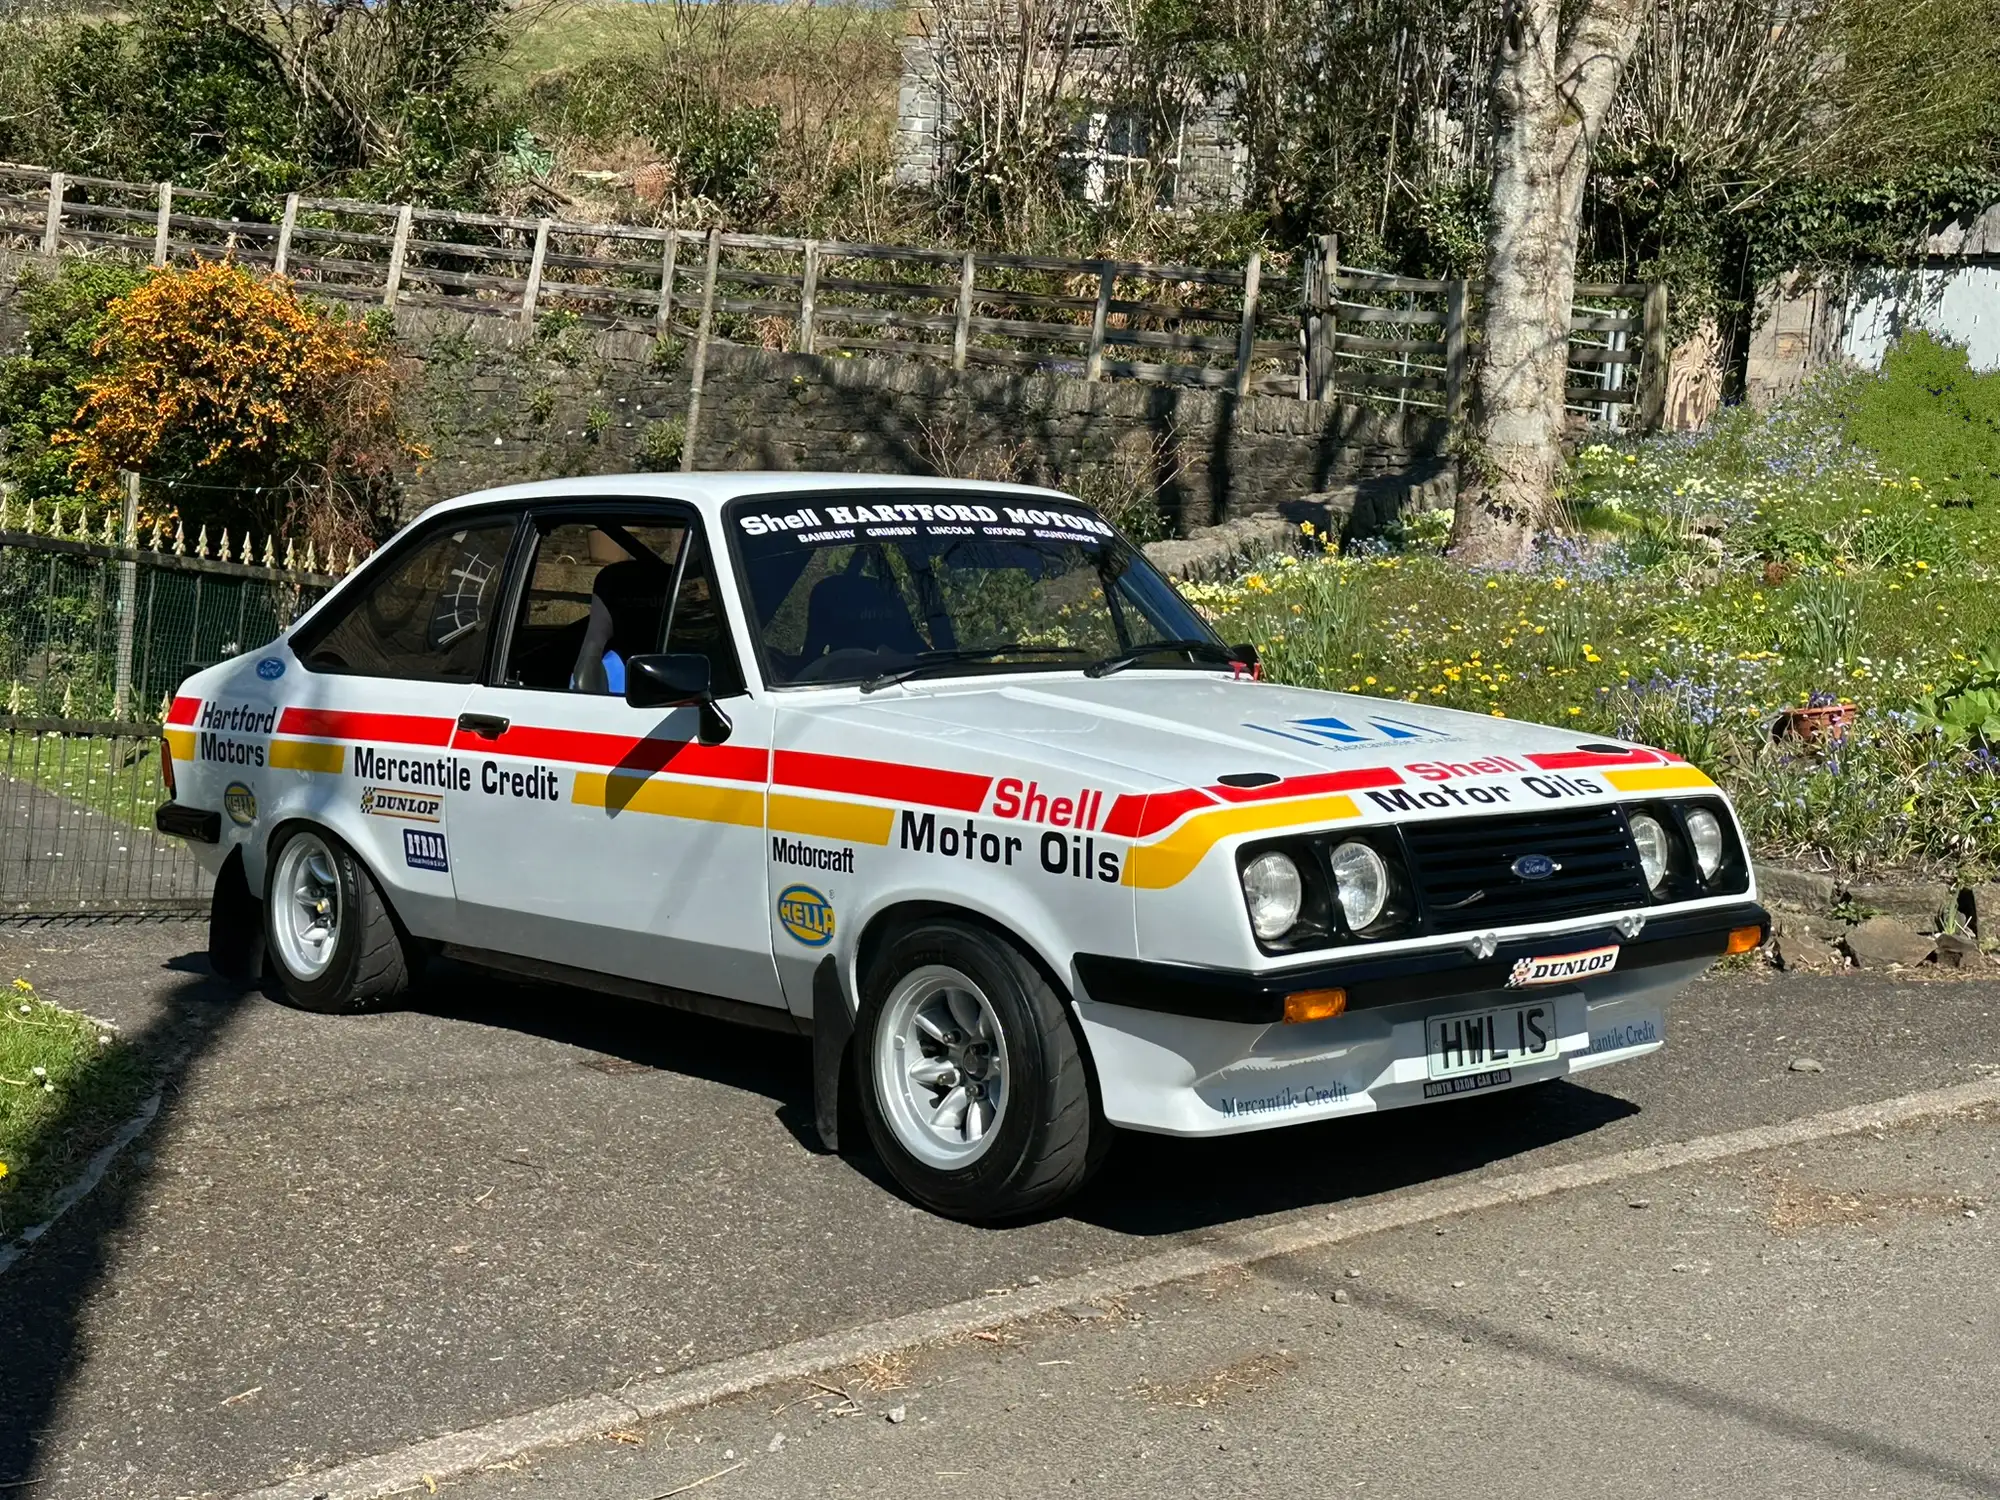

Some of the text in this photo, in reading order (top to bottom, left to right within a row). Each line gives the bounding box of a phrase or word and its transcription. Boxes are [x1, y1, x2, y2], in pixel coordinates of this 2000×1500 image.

[740, 504, 1114, 537] Shell HARTFORD MOTORS
[797, 526, 1099, 544] BANBURY GRIMSBY LINCOLN OXFORD SCUNTHORPE
[201, 701, 277, 734] Hartford
[201, 732, 265, 767] Motors
[354, 746, 559, 801] Mercantile Credit
[1404, 755, 1526, 781] Shell
[376, 795, 439, 815] DUNLOP
[992, 778, 1102, 831] Shell
[1364, 774, 1604, 813] Motor Oils
[407, 833, 444, 859] BTRDA
[772, 836, 855, 874] Motorcraft
[900, 810, 1120, 884] Motor Oils
[1524, 859, 1547, 874] Ford
[782, 901, 835, 935] HELLA
[1531, 954, 1613, 979] DUNLOP
[1441, 1015, 1509, 1069] HWL
[1625, 1020, 1657, 1045] Credit
[1221, 1080, 1349, 1119] Mercantile Credit
[1426, 1082, 1452, 1096] NORTH
[1454, 1077, 1475, 1091] OXON
[1477, 1074, 1492, 1087] CAR
